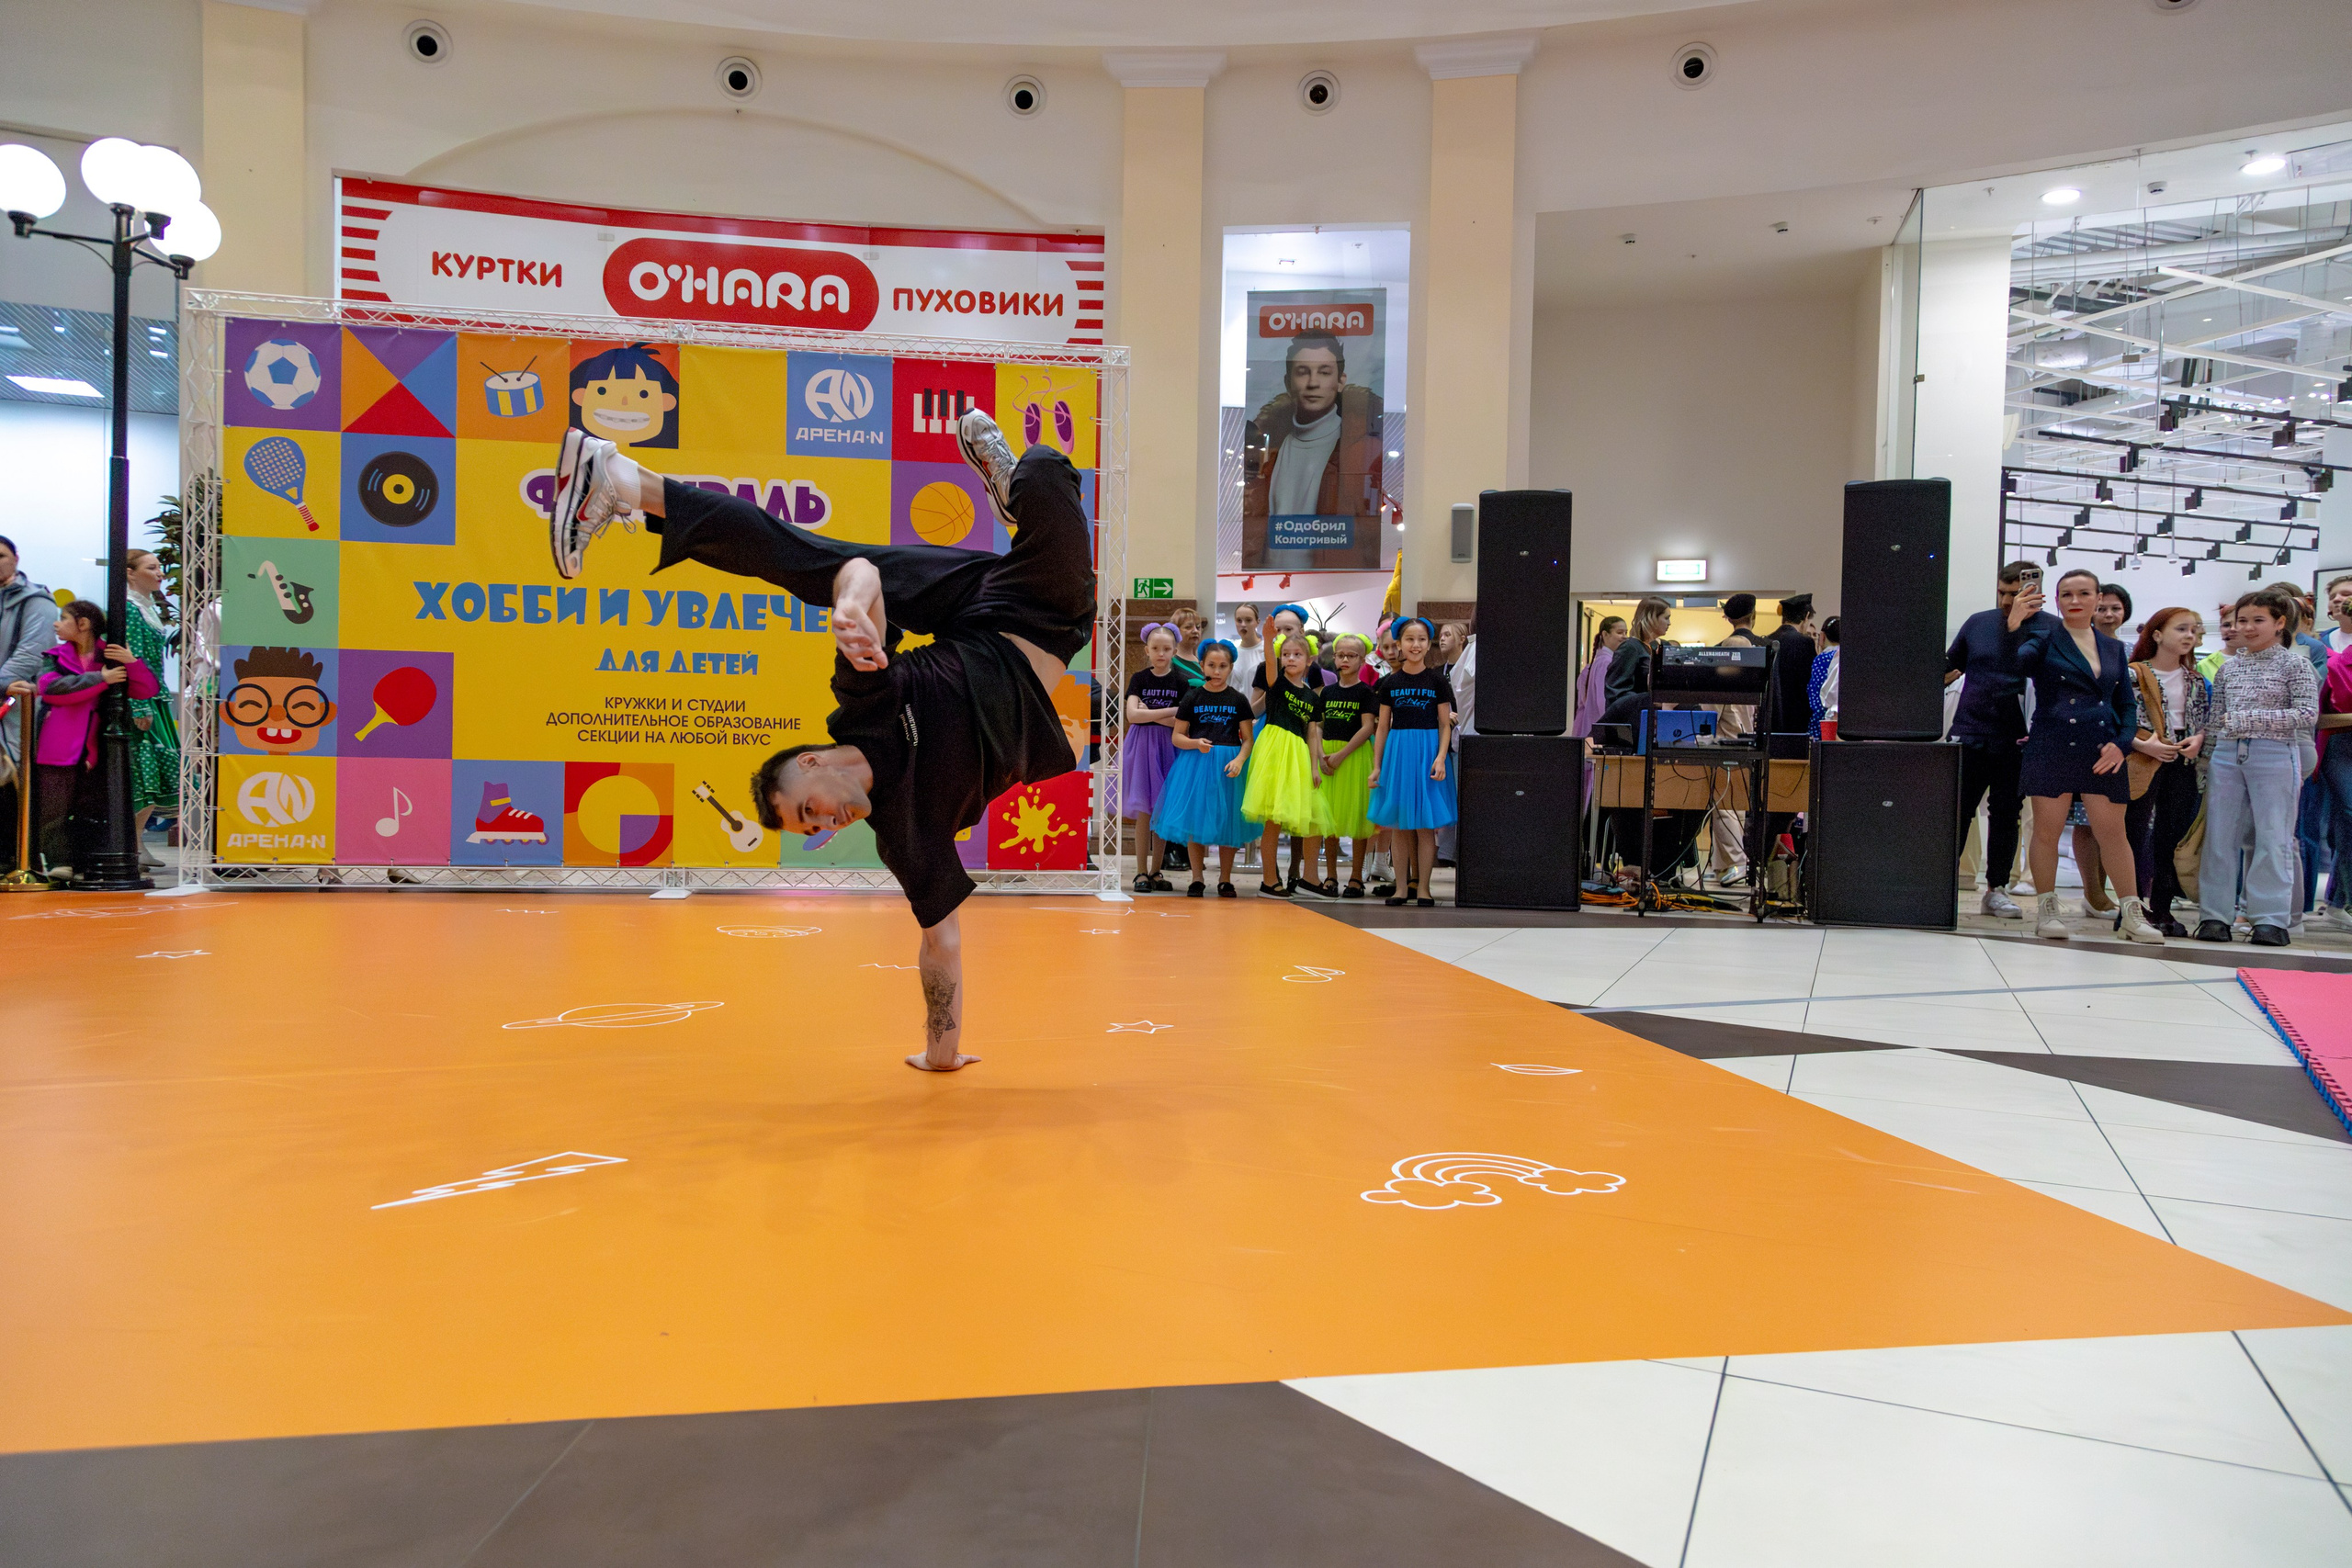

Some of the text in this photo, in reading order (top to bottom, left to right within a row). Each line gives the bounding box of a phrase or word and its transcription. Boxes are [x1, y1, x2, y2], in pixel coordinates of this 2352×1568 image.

[432, 251, 562, 288] КУРТКИ
[628, 261, 850, 314] O'HARA
[893, 288, 1064, 317] ПУХОВИКИ
[1269, 310, 1364, 331] O'HARA
[1275, 520, 1346, 533] #Одобрил
[1275, 535, 1347, 546] Кологривый
[413, 581, 835, 633] ХОББИ И УВЛЕЧЕ
[594, 648, 759, 675] ДЛЯ ДЕТЕЙ
[1142, 689, 1178, 698] EAUTIFU
[1390, 688, 1437, 698] BEAUTIFUL
[605, 696, 746, 714] КРУЖКИ И СТУДИИ
[1194, 705, 1237, 714] BEAUTIFUL
[1326, 701, 1360, 710] EAUTIFU
[546, 712, 801, 730] ДОПОЛНИТЕЛЬНОЕ ОБРАЗОВАНИЕ
[577, 729, 771, 746] СЕКЦИИ НА ЛЮБОЙ ВКУС
